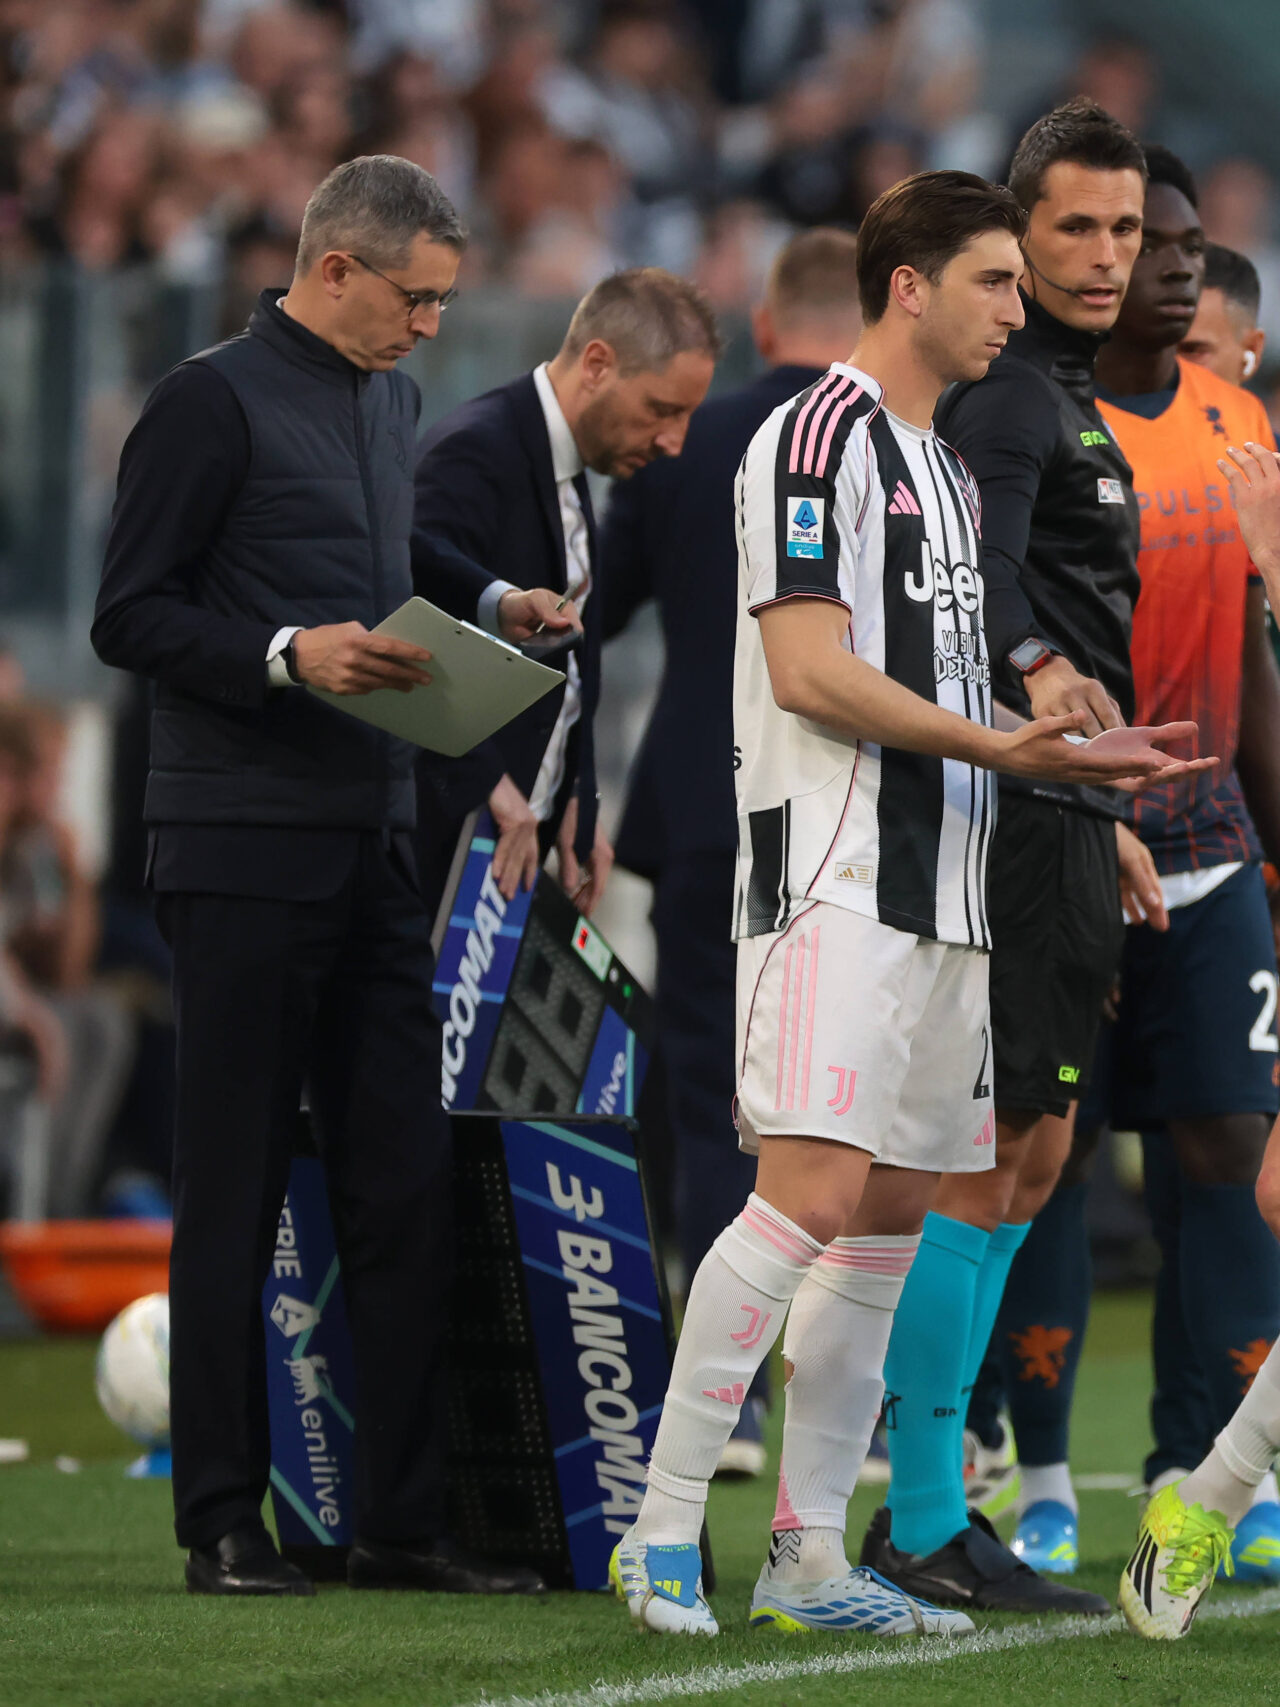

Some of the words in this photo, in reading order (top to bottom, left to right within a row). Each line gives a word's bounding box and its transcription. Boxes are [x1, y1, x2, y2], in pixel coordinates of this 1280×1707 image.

[792, 530, 811, 538] SERIE
[942, 629, 977, 656] VISIT
[300, 1408, 341, 1527] enilive
